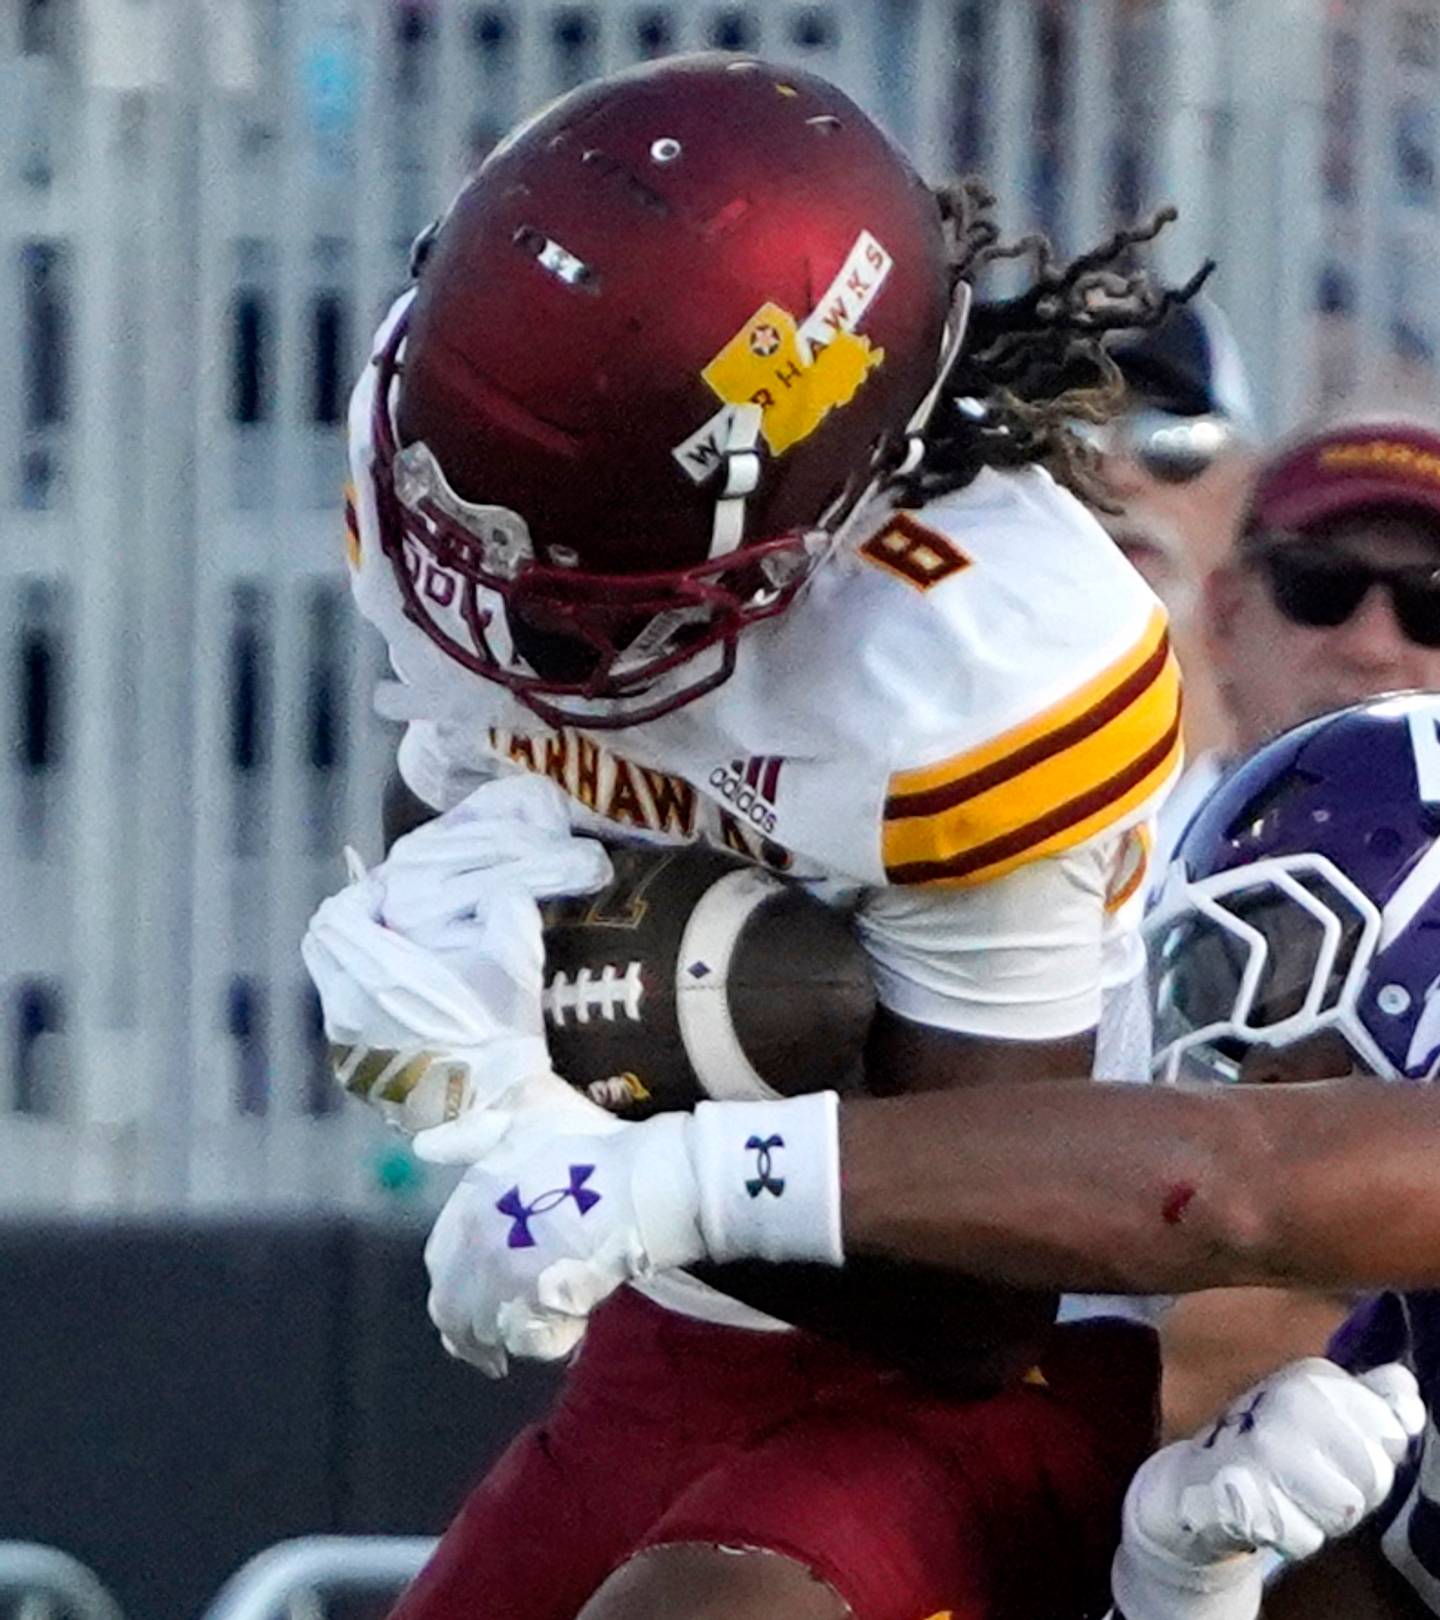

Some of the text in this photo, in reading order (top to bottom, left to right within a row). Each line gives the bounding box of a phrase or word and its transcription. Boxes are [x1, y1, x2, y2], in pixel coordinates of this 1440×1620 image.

[686, 243, 886, 468] WRHAWKS
[857, 510, 975, 592] 8
[488, 724, 792, 870] ARHAW
[708, 765, 778, 835] adidas
